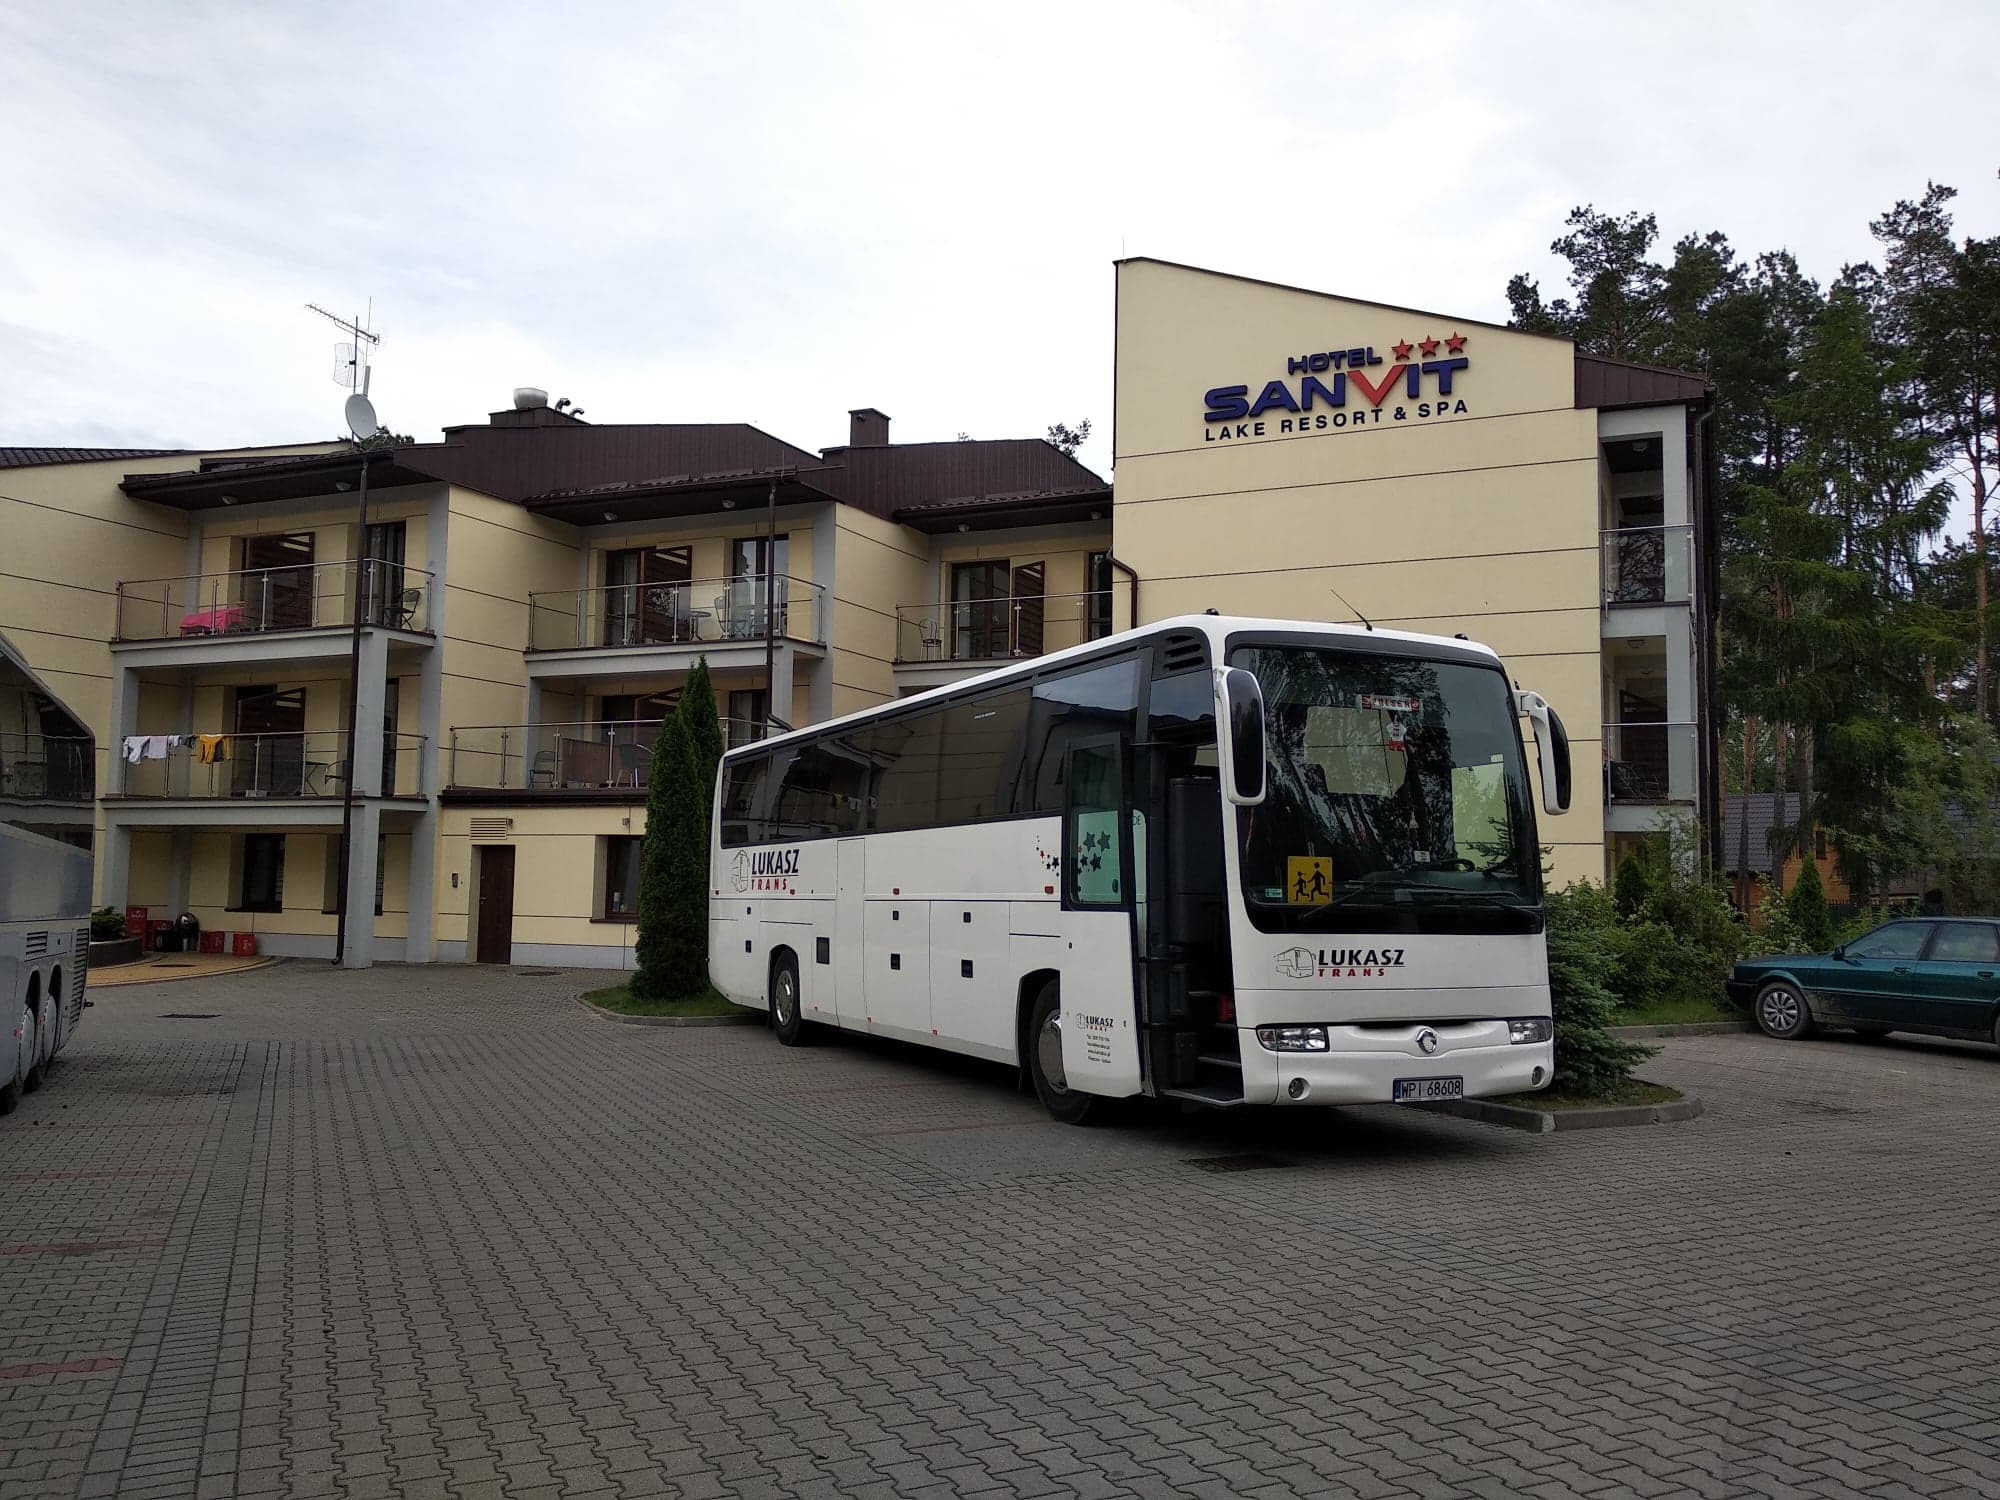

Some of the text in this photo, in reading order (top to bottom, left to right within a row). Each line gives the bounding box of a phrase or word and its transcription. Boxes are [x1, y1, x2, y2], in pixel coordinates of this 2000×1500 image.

[1288, 347, 1382, 375] HOTEL
[1204, 357, 1469, 422] SANVIT
[1205, 400, 1468, 442] LAKE RESORT & SPA
[751, 849, 800, 875] LUKASZ
[751, 878, 787, 891] TRANS
[1318, 949, 1404, 966] LUKASZ
[1318, 968, 1385, 977] TRANS
[1086, 1015, 1114, 1028] LUKASZ
[1402, 1080, 1461, 1098] WPI 68608
